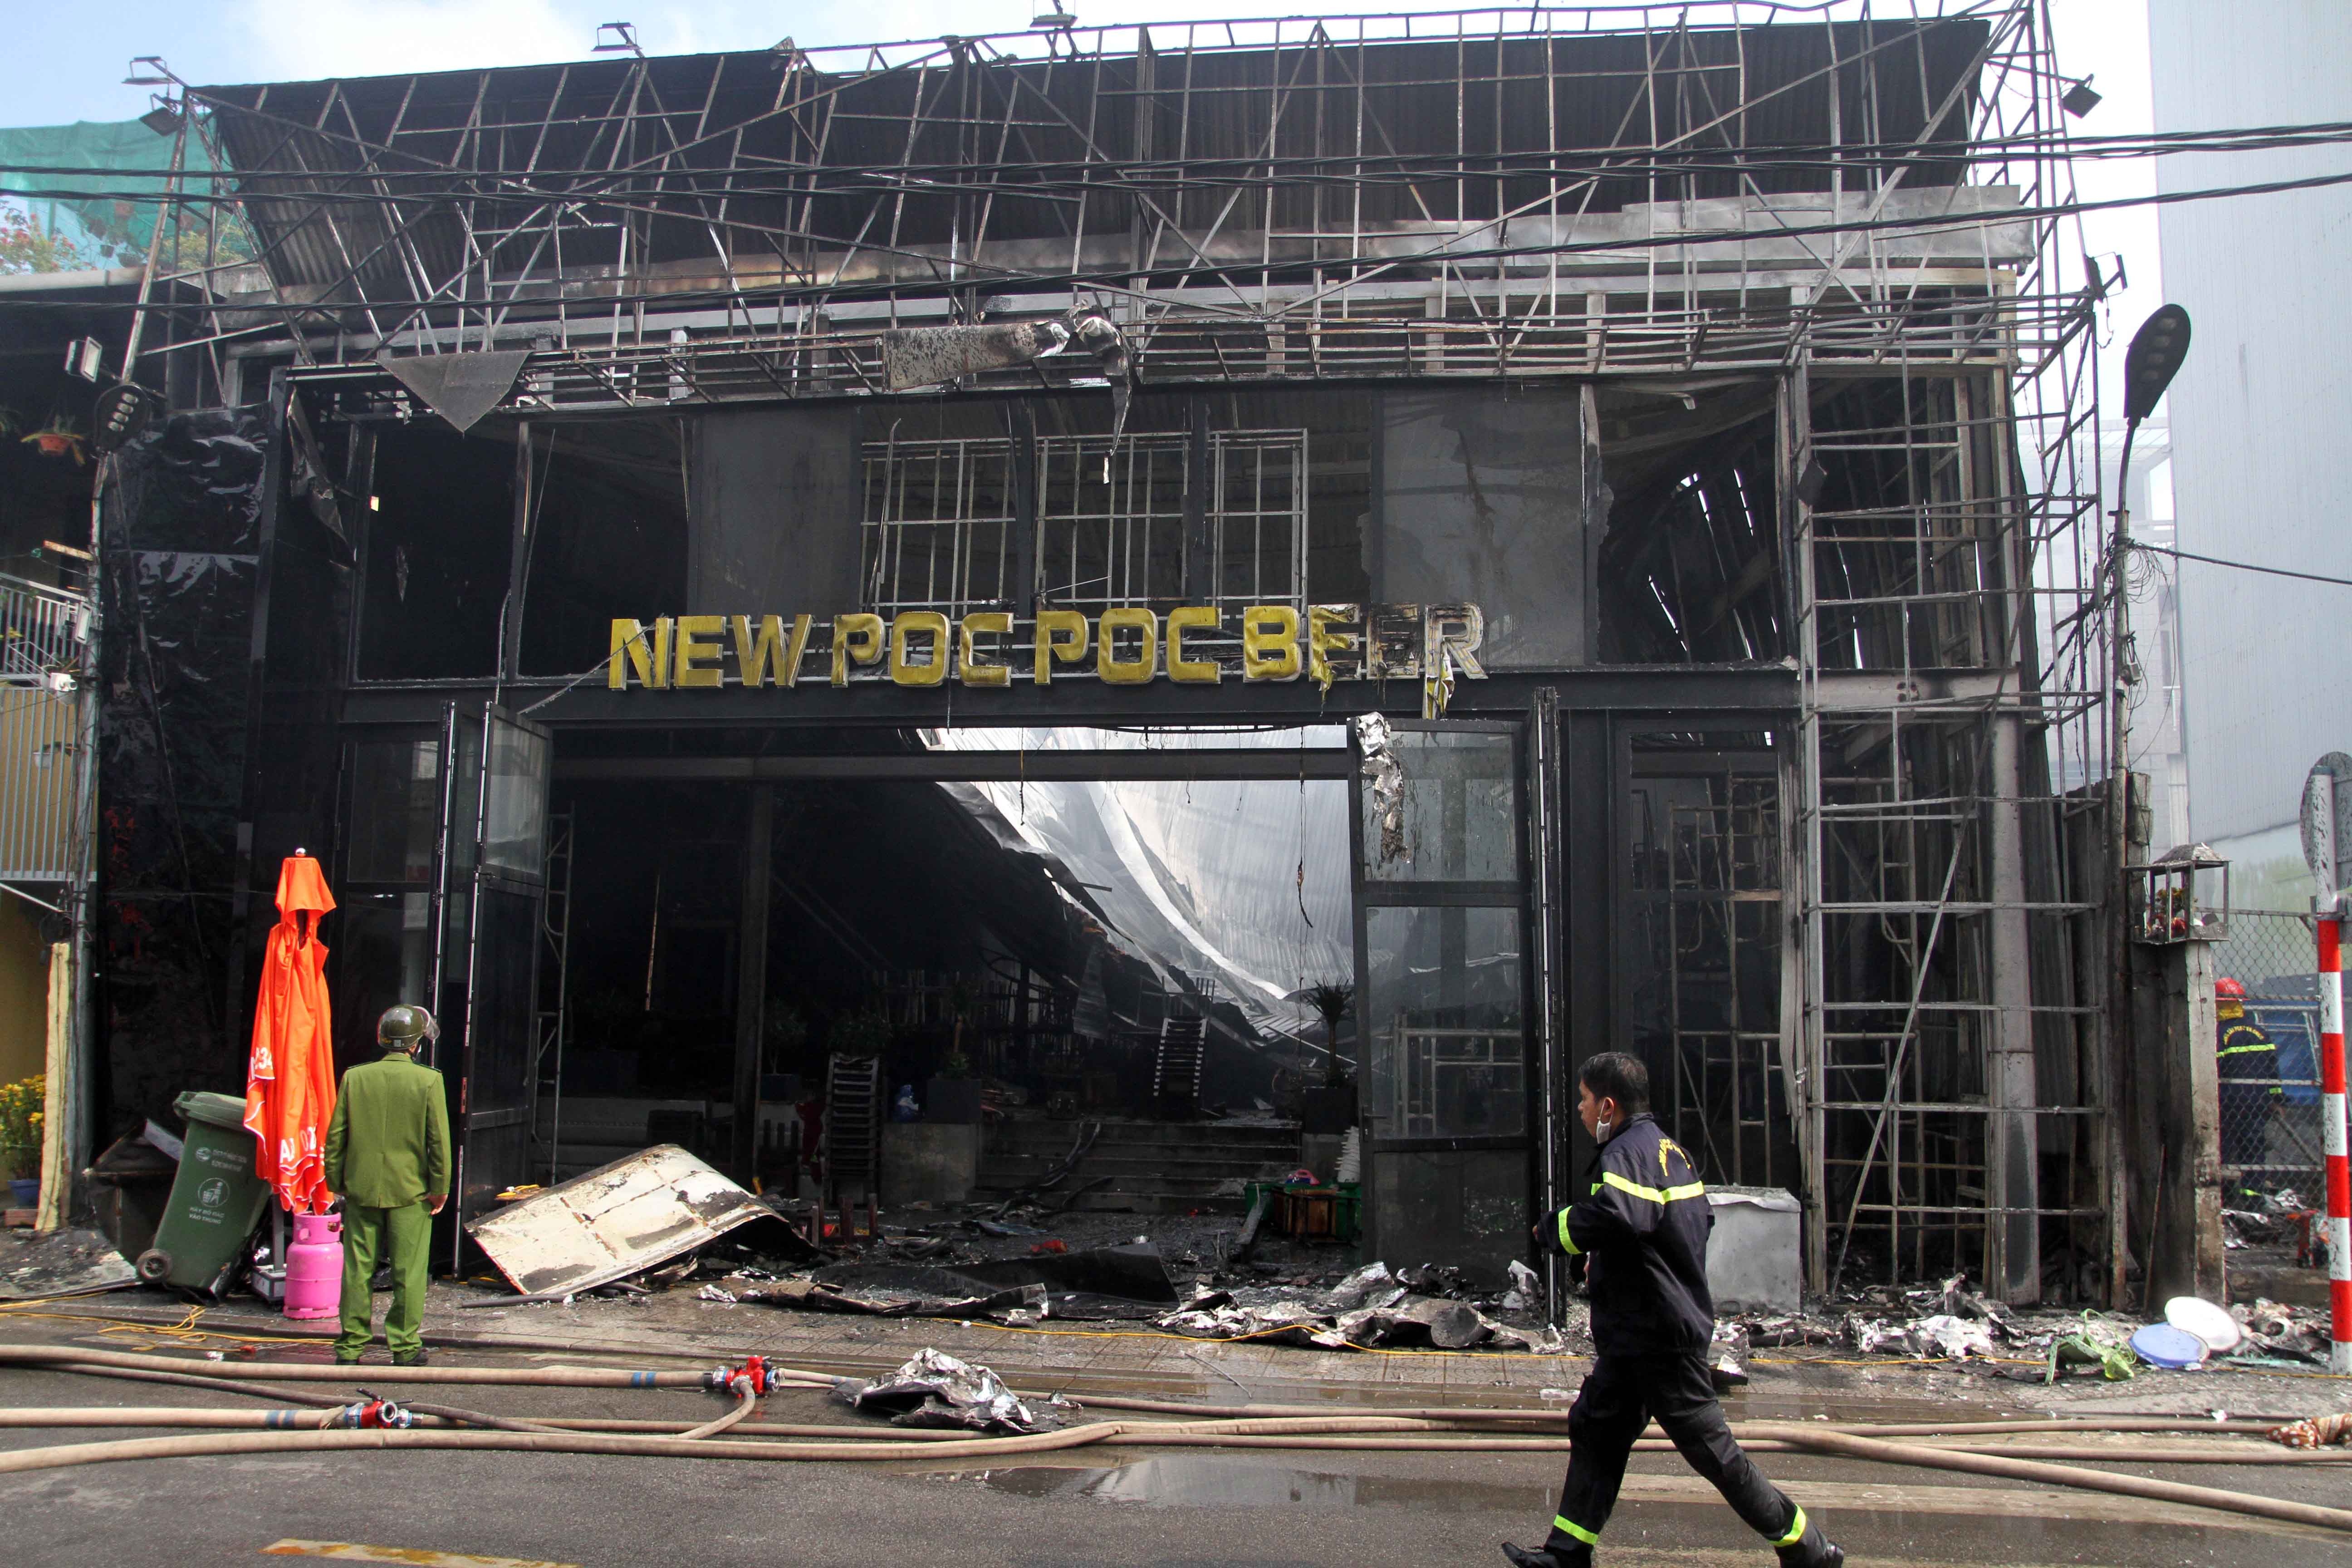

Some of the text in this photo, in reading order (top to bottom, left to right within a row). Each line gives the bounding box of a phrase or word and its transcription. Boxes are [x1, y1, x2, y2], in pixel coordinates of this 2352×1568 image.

[608, 614, 812, 691] NEW
[831, 612, 1014, 688] POC
[1034, 607, 1223, 686] POC
